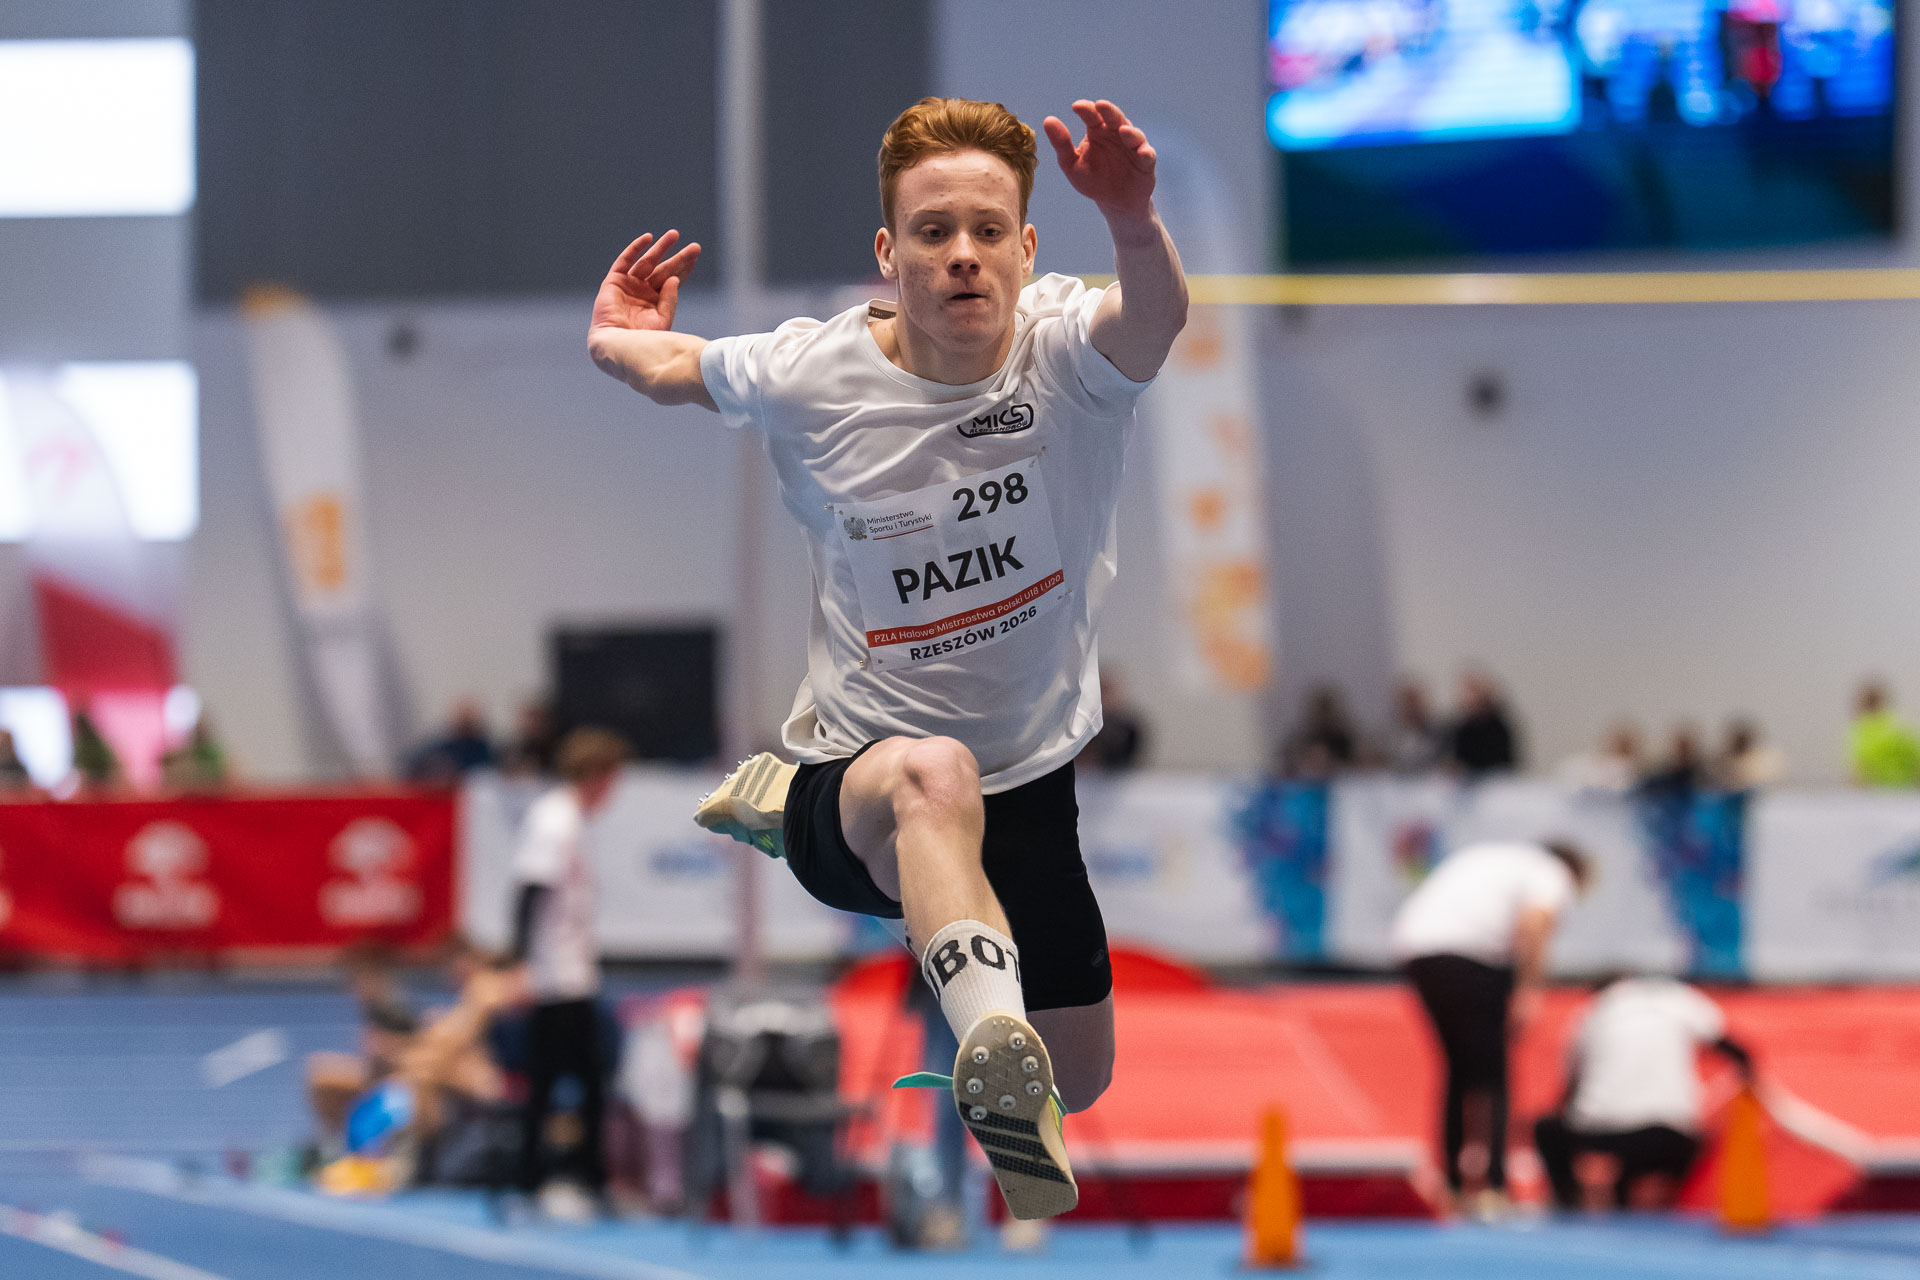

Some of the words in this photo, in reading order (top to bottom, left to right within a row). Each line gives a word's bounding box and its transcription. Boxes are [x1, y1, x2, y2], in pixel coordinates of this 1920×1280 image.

[866, 510, 914, 525] Ministerstwo
[952, 472, 1028, 522] 298
[869, 525, 893, 534] Sportu
[898, 513, 932, 528] Turystyki
[892, 535, 1025, 604] PAZIK
[874, 632, 897, 643] PZLA
[899, 628, 935, 640] Halowe
[936, 609, 996, 633] Mistrzostwa
[997, 596, 1023, 614] Polski
[1024, 586, 1039, 600] U18
[1040, 583, 1044, 592] i
[1044, 574, 1061, 588] U20
[910, 626, 995, 660] RZESZÓW
[999, 606, 1037, 634] 2026
